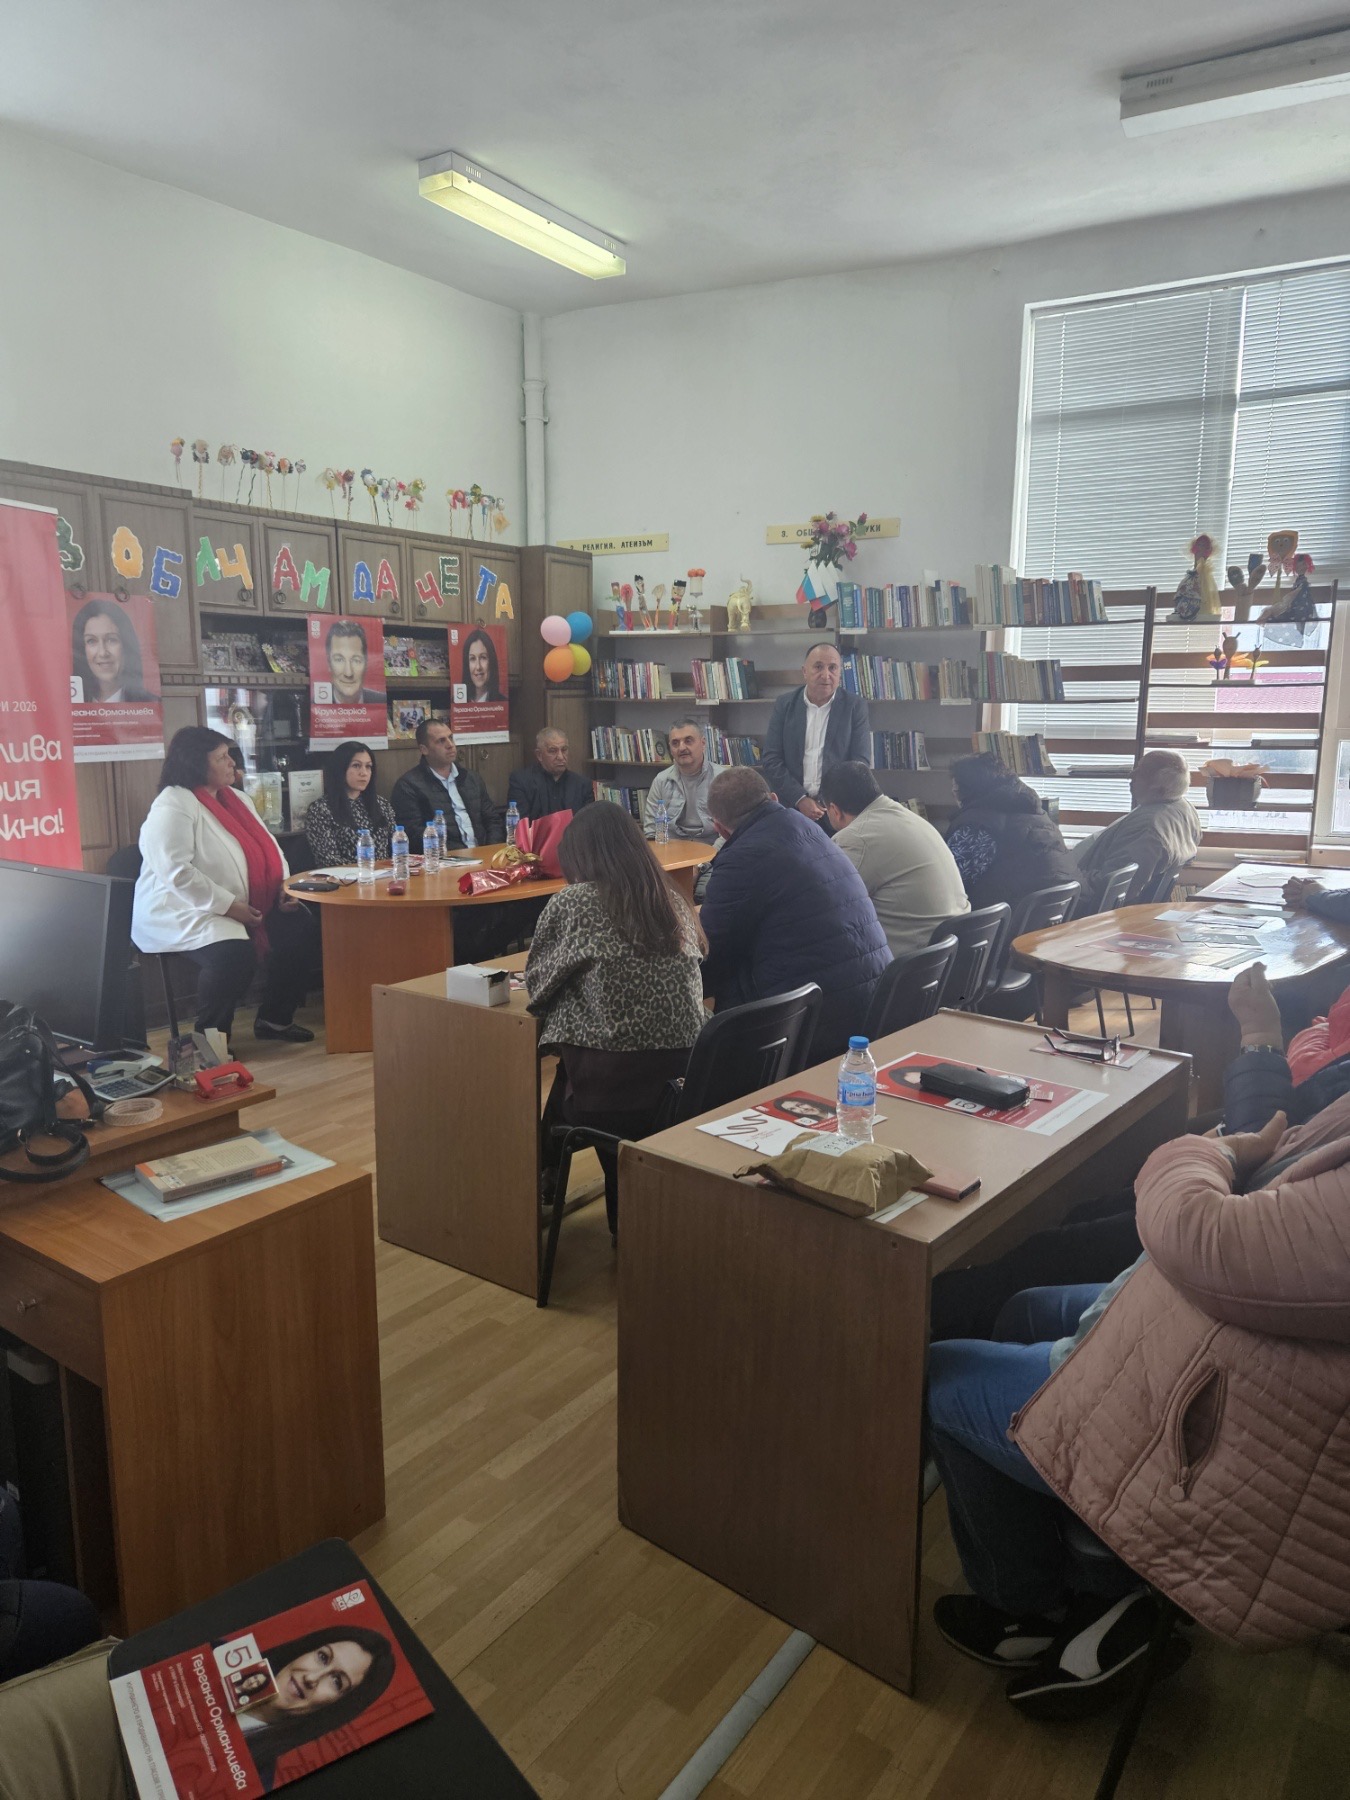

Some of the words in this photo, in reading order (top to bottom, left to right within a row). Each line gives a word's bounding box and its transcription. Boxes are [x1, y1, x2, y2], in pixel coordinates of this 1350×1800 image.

[582, 543, 616, 552] РЕЛИГИЯ.
[620, 539, 653, 549] АТЕИЗЪМ
[352, 559, 399, 604] ДА
[415, 556, 514, 620] ЧЕТА
[318, 686, 328, 700] 5
[456, 687, 464, 700] 5
[13, 700, 38, 712] 2026
[98, 707, 154, 717] Орманлиева
[314, 707, 337, 717] Крум
[337, 707, 367, 717] Зарков
[0, 779, 41, 802] ия
[224, 1645, 252, 1668] 5
[191, 1653, 216, 1707] Гергана
[210, 1706, 247, 1790] Орманлиева
